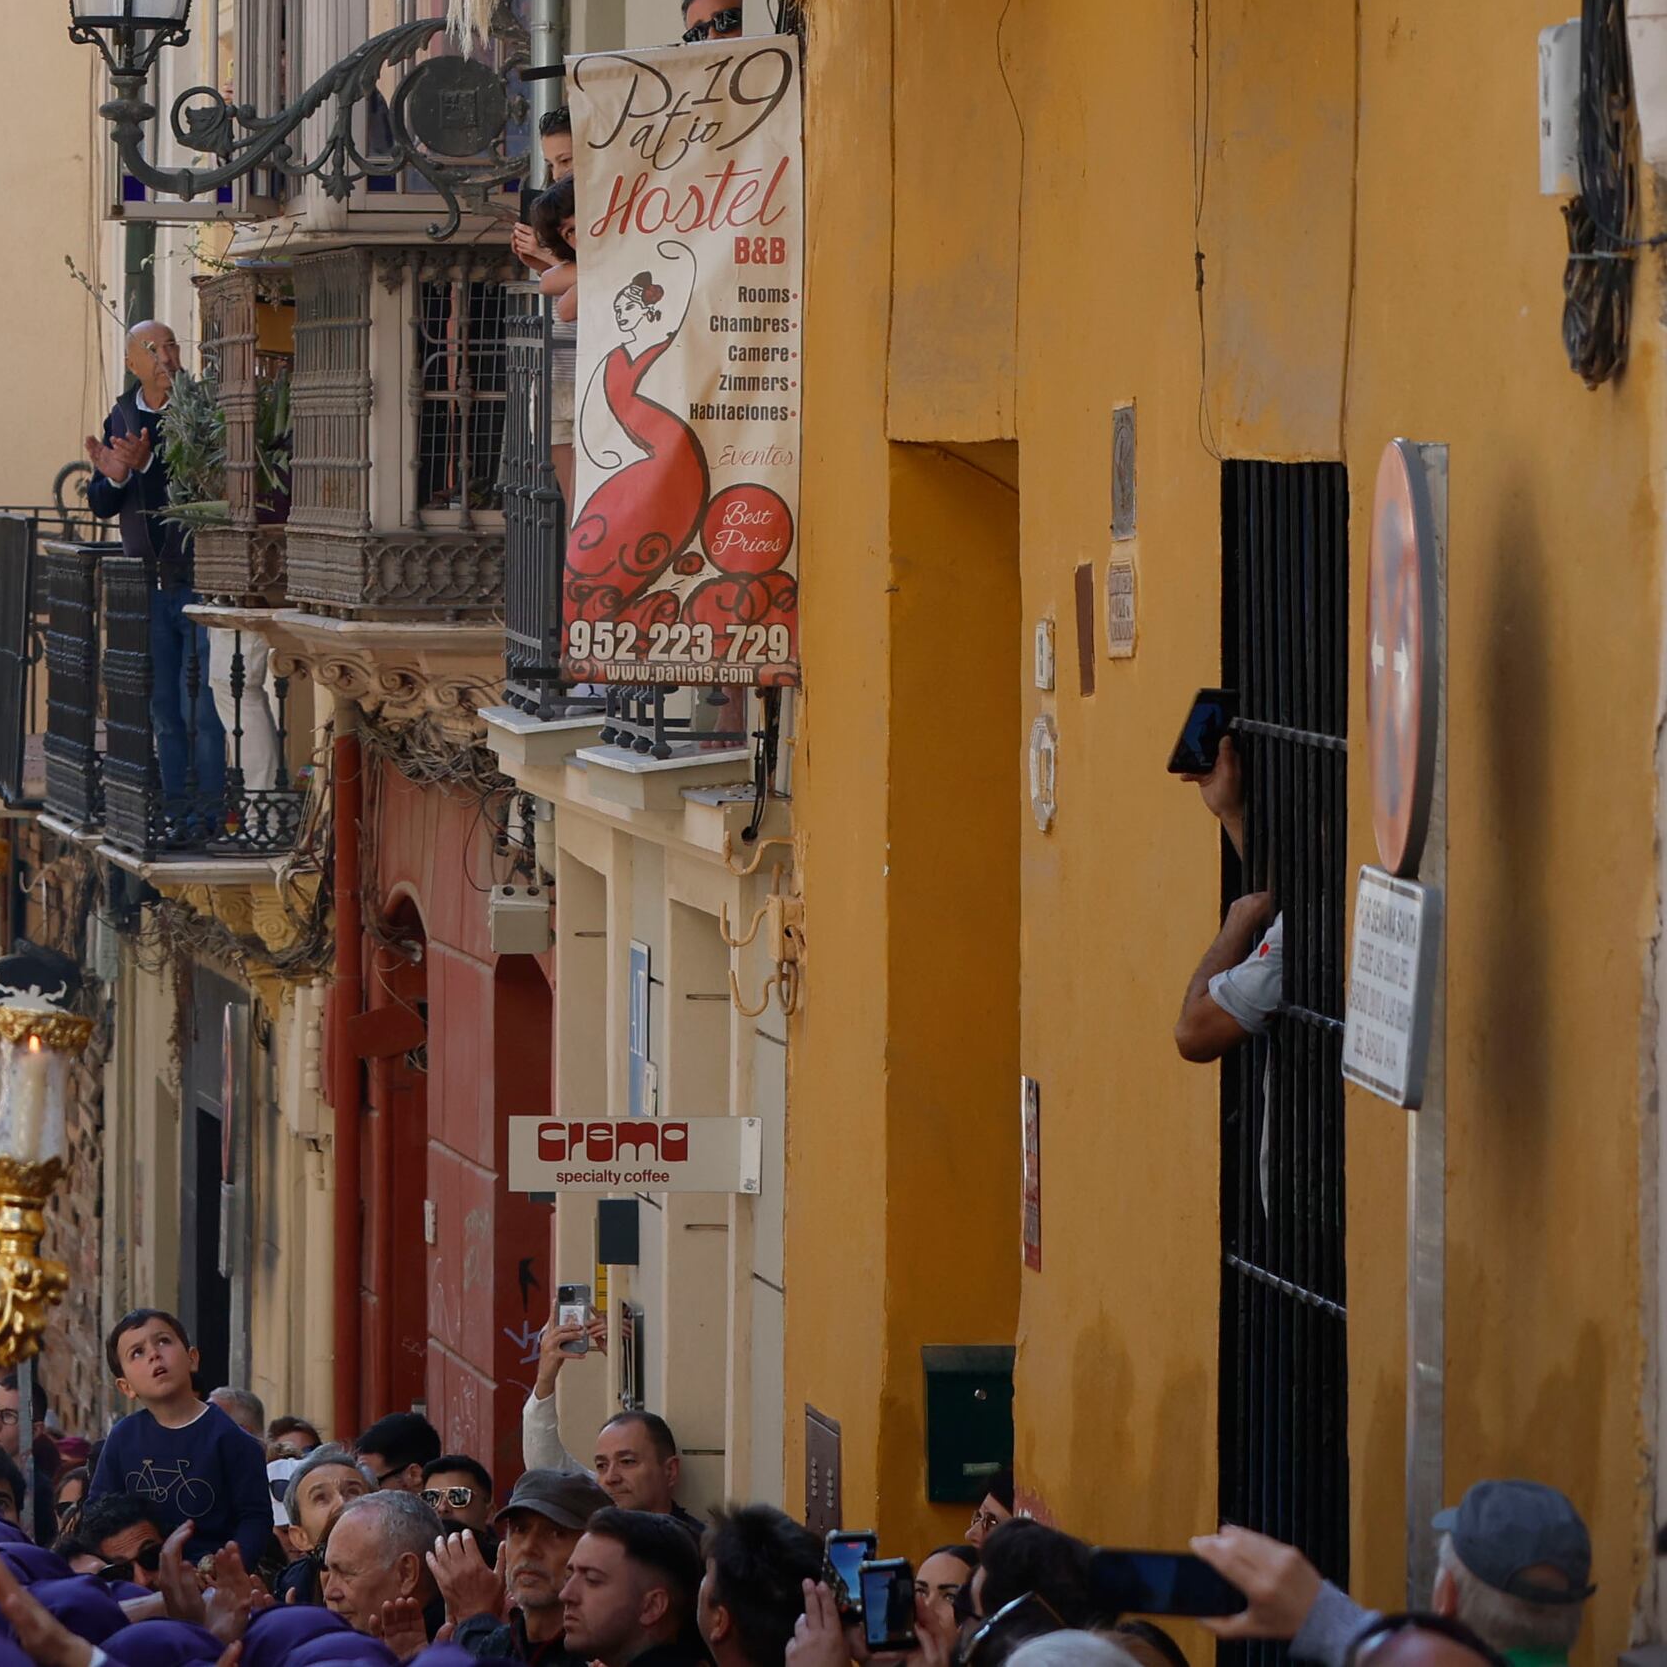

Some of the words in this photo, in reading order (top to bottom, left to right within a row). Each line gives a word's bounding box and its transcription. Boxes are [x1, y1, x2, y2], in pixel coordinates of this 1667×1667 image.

[574, 54, 723, 170] Patio
[691, 48, 793, 151] 19
[590, 156, 789, 237] Hostel
[734, 236, 786, 264] B&B
[738, 286, 790, 303] Rooms
[710, 315, 789, 332] Chambres
[728, 345, 789, 362] Camere
[719, 374, 789, 391] Zimmers
[690, 403, 788, 421] Habitaciones
[710, 443, 794, 469] Eventos
[722, 501, 773, 526] Best
[711, 529, 782, 555] Prices
[568, 620, 637, 661] 952
[648, 621, 713, 663] 223
[725, 623, 789, 664] 729
[605, 664, 754, 683] www.patio19.com
[537, 1122, 688, 1162] crema
[556, 1170, 621, 1185] specialty
[624, 1169, 670, 1183] coffee
